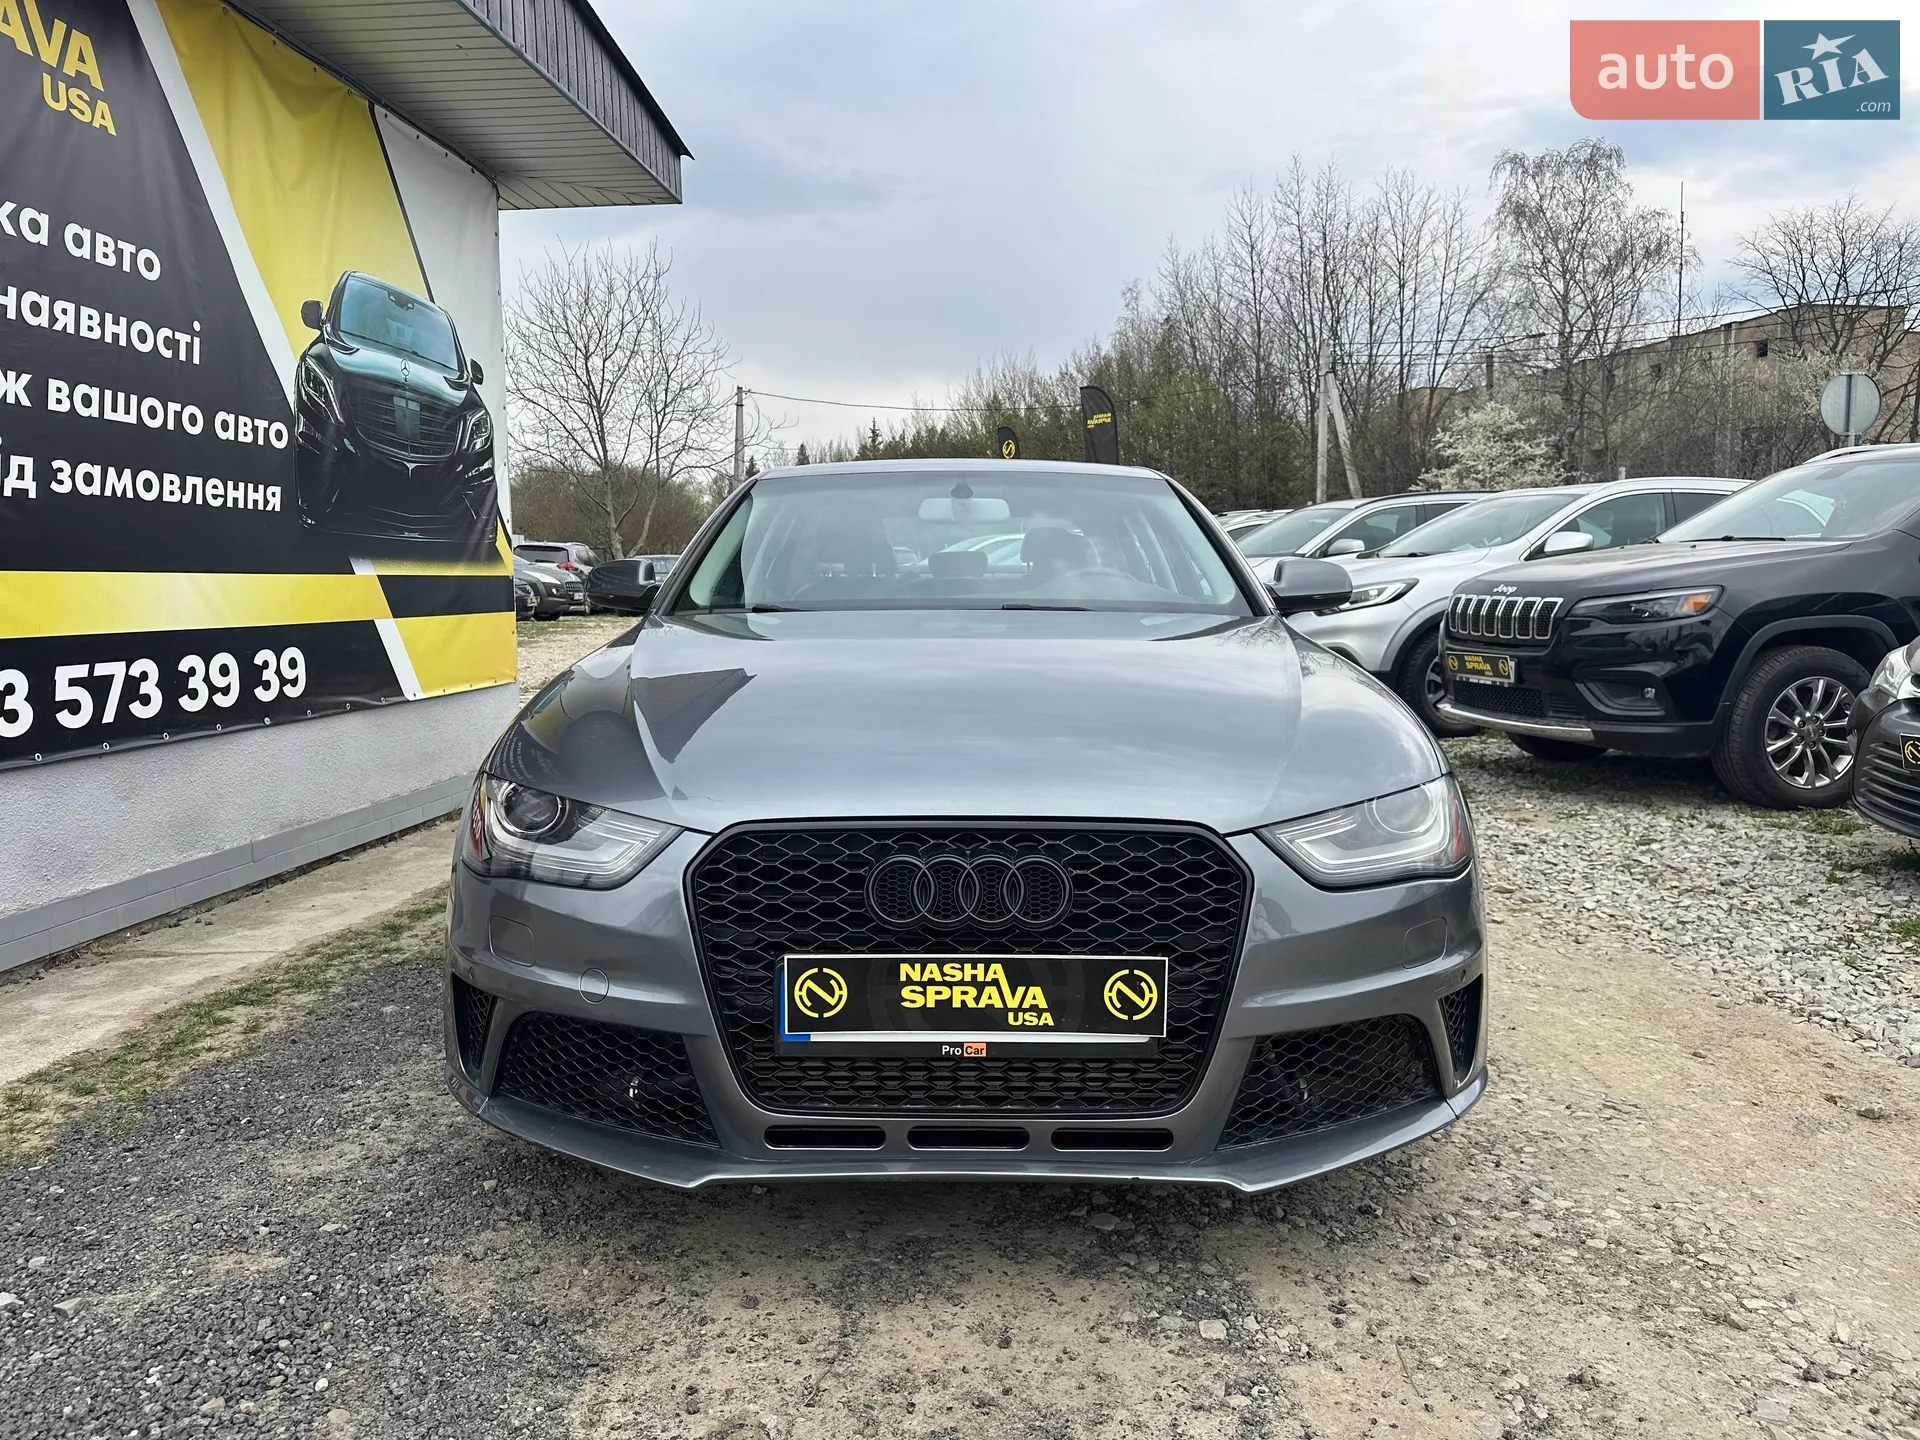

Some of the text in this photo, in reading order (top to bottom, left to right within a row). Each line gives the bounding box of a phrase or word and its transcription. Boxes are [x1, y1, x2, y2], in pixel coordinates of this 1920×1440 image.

[42, 72, 117, 137] USA
[64, 222, 161, 281] авто
[47, 377, 204, 436] вашого
[214, 410, 290, 450] авто
[49, 459, 282, 512] замовлення
[1492, 583, 1518, 595] Jeep
[1465, 661, 1492, 671] SPRAVA
[54, 658, 164, 729] 573
[177, 651, 240, 713] 39
[253, 646, 307, 703] 39
[899, 962, 1003, 982] NASHA
[900, 985, 1049, 1009] SPRAVA
[1007, 1011, 1055, 1027] USA
